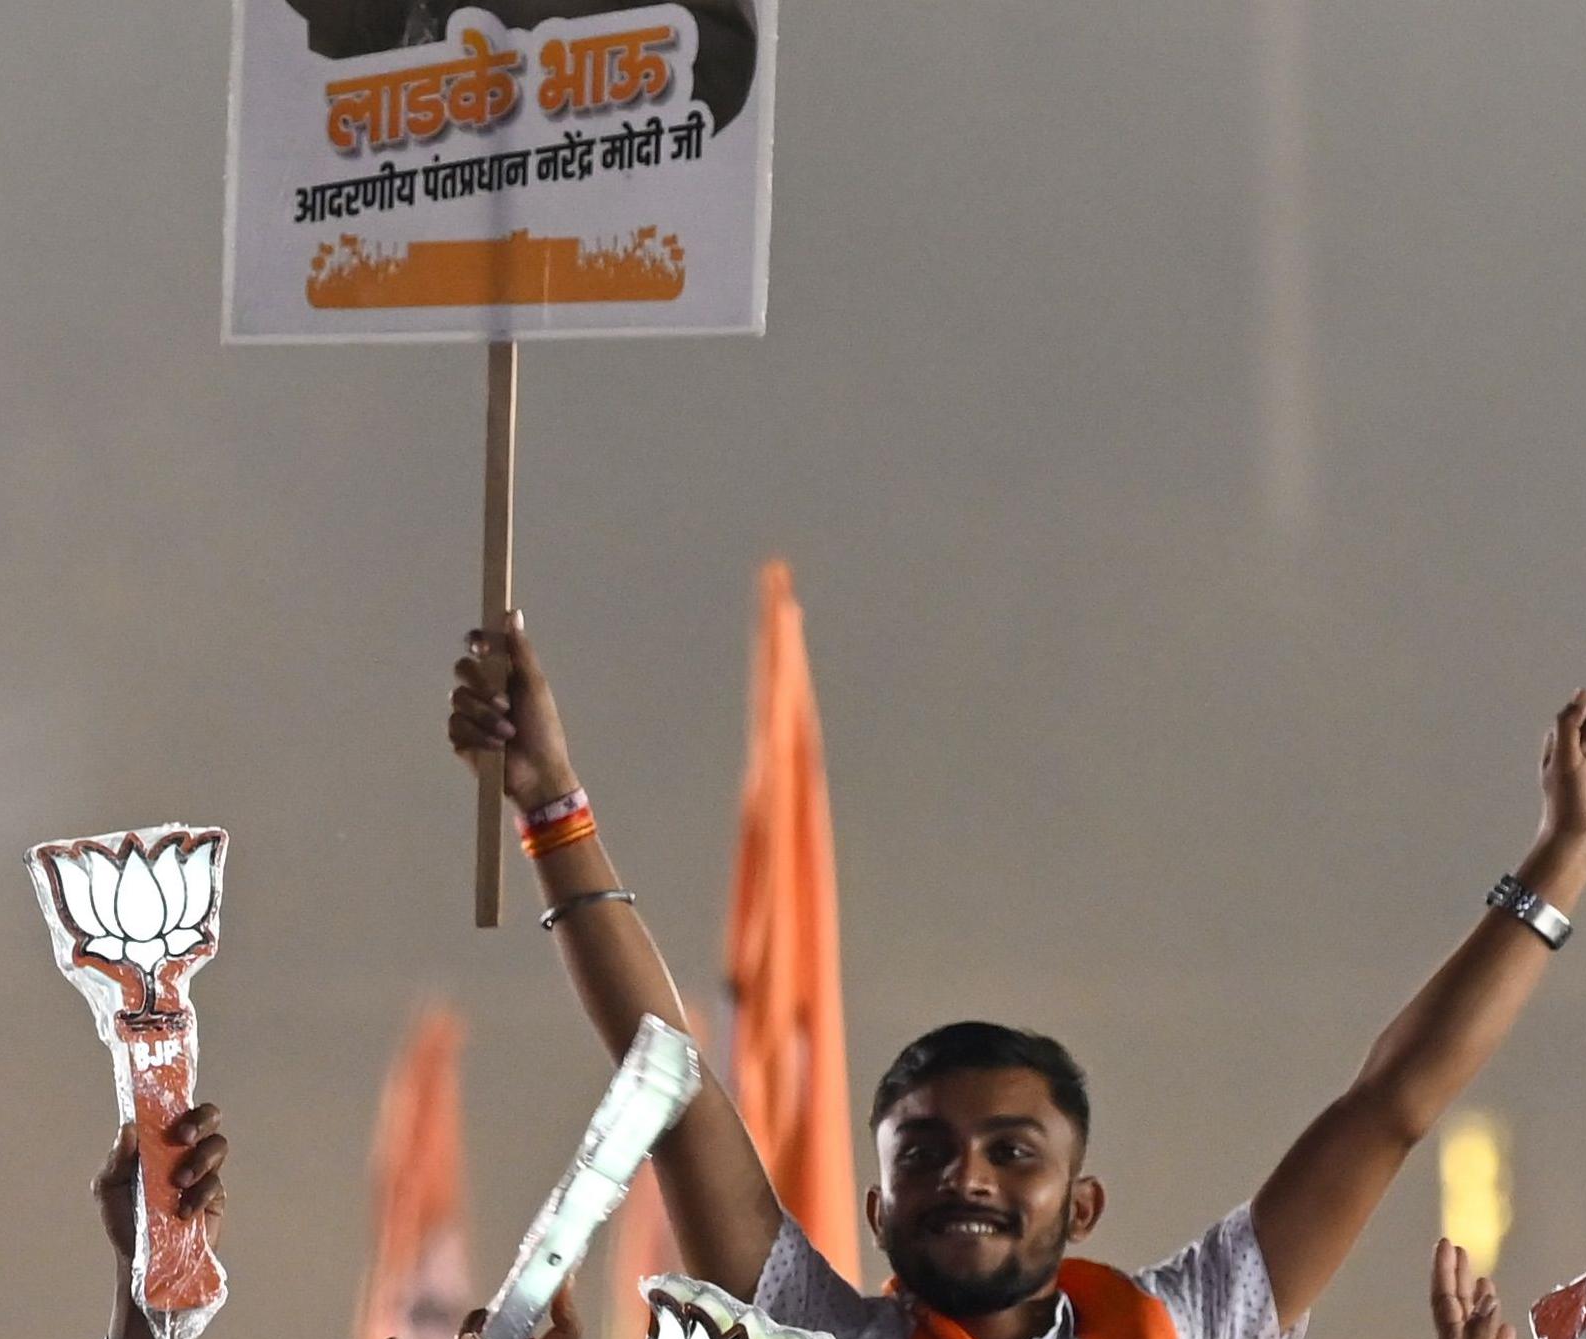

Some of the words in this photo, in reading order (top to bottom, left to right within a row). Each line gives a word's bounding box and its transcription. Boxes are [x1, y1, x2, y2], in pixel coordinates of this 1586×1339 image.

[325, 28, 521, 151] लाडके
[538, 25, 677, 114] भाऊ
[294, 162, 417, 225] आदरणीय
[421, 155, 531, 202] पंतप्रधान
[536, 131, 599, 181] नरेंद्र
[600, 117, 665, 172] मोदी
[668, 110, 706, 161] जी
[133, 1039, 183, 1072] BJP
